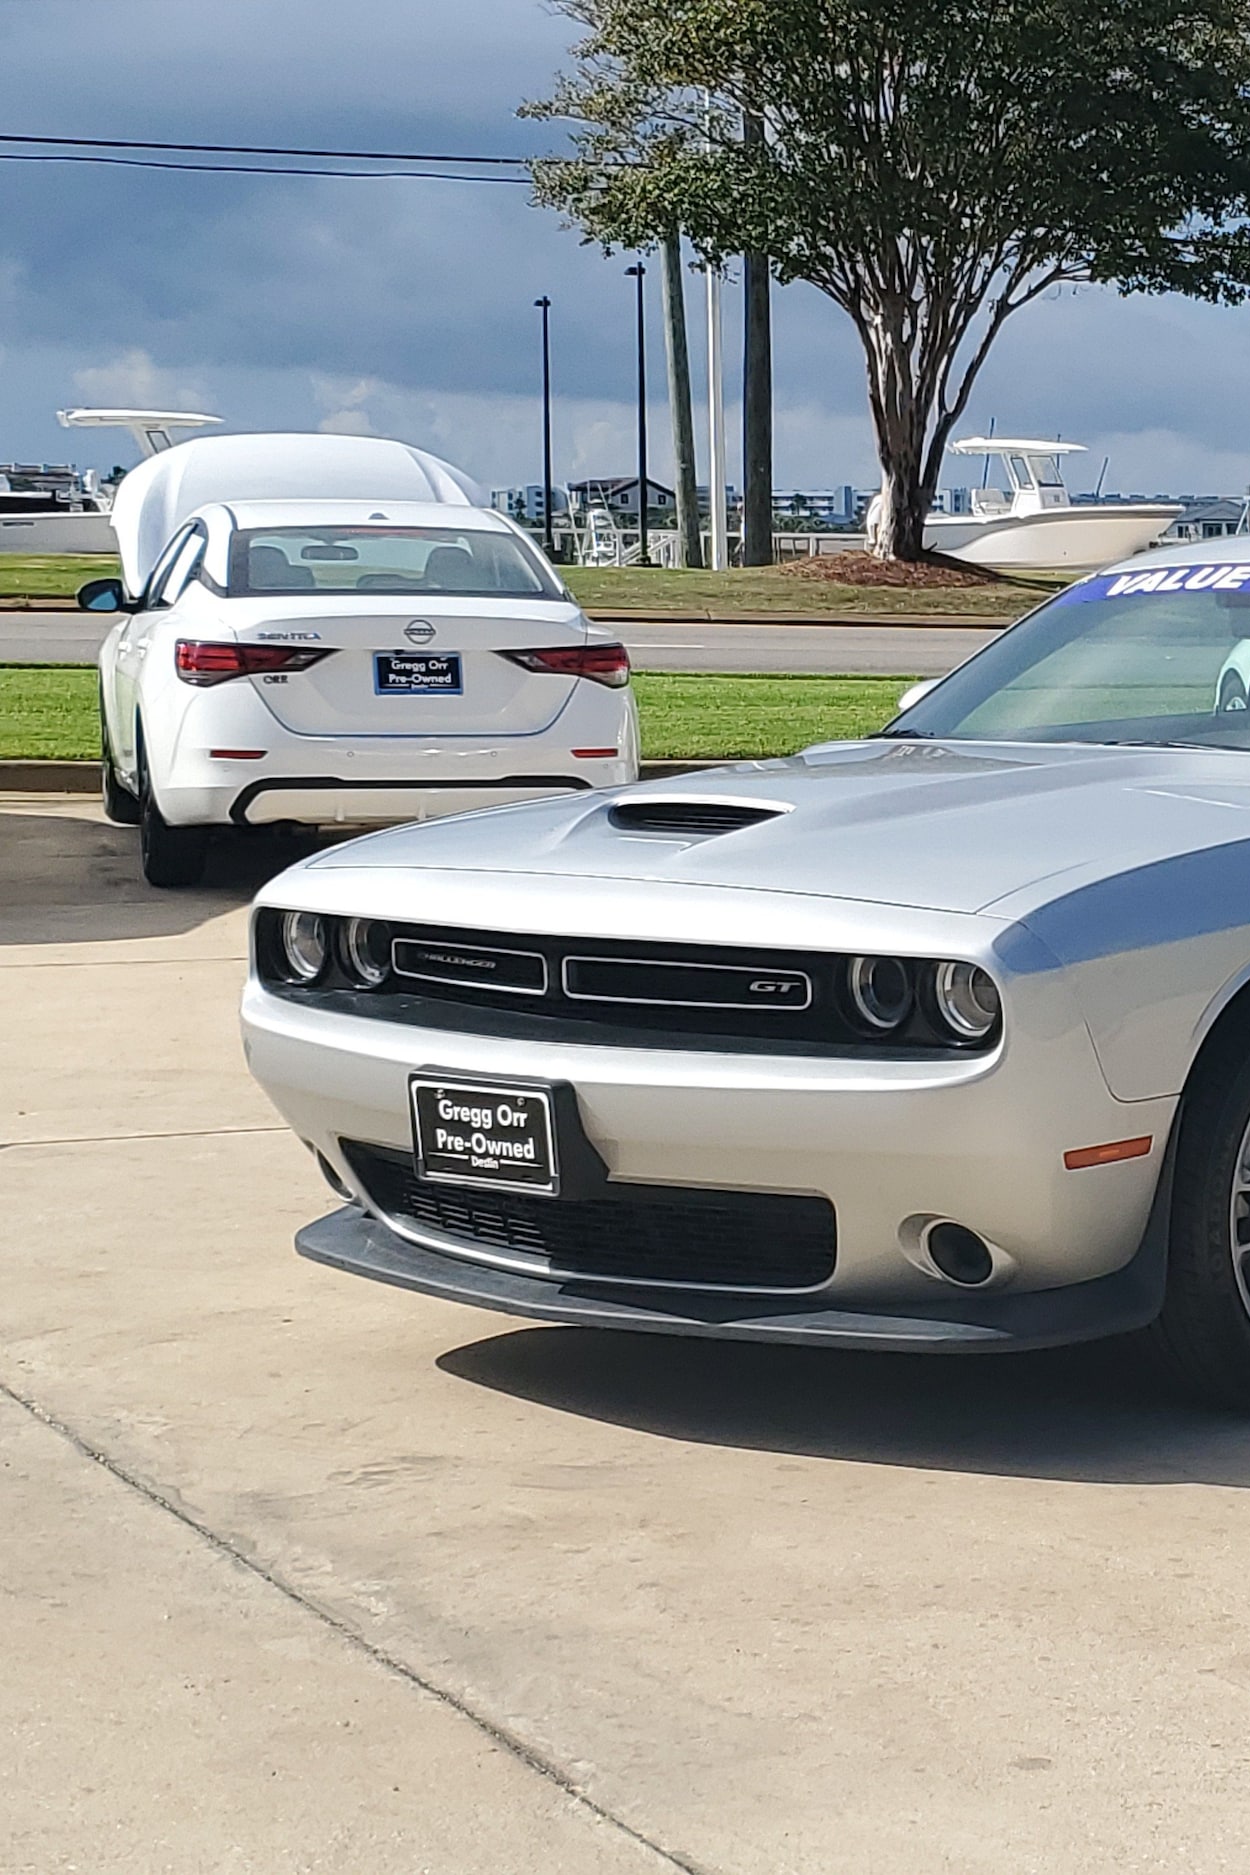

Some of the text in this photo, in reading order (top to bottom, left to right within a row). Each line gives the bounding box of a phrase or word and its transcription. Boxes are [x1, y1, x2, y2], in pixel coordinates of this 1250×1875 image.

[391, 660, 448, 672] Gregg Orr
[388, 673, 452, 683] Pre-Owned
[749, 981, 801, 993] GT
[438, 1100, 528, 1129] Gregg Orr
[435, 1128, 535, 1159] Pre-Owned
